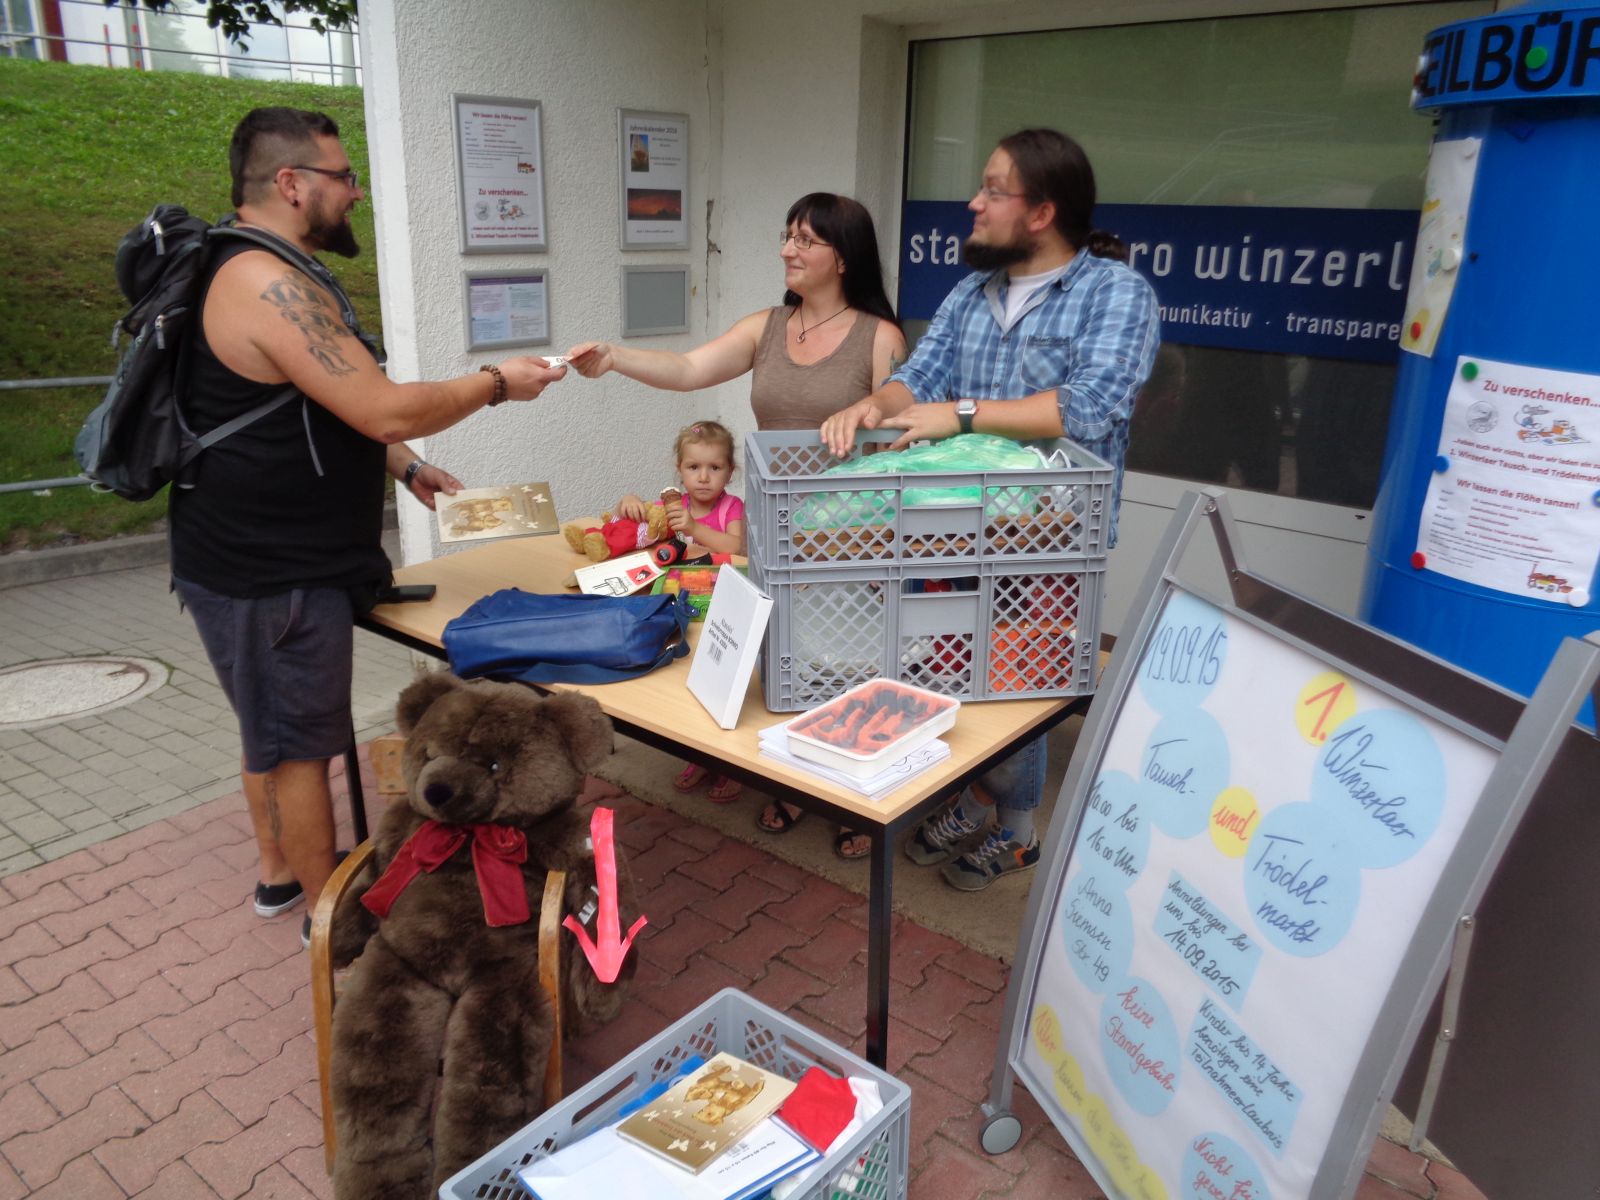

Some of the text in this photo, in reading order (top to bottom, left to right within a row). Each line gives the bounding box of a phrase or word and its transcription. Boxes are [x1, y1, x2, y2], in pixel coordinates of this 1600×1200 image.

[1419, 11, 1600, 98] EILBÜR
[909, 227, 961, 266] sta
[1286, 311, 1402, 341] transpare
[1483, 380, 1499, 392] Zu
[1532, 466, 1549, 475] und
[1457, 478, 1471, 487] Wir
[1472, 482, 1497, 495] lassen
[1499, 488, 1513, 499] die
[1515, 491, 1541, 504] Flöhe
[1304, 681, 1345, 742] 1.
[1322, 724, 1416, 839] Winzerlaer
[1114, 803, 1139, 833] bis
[1212, 804, 1257, 841] und
[1257, 900, 1322, 944] markt
[1199, 999, 1233, 1036] Kinder
[1229, 1035, 1251, 1058] bis
[1252, 1053, 1267, 1071] 14
